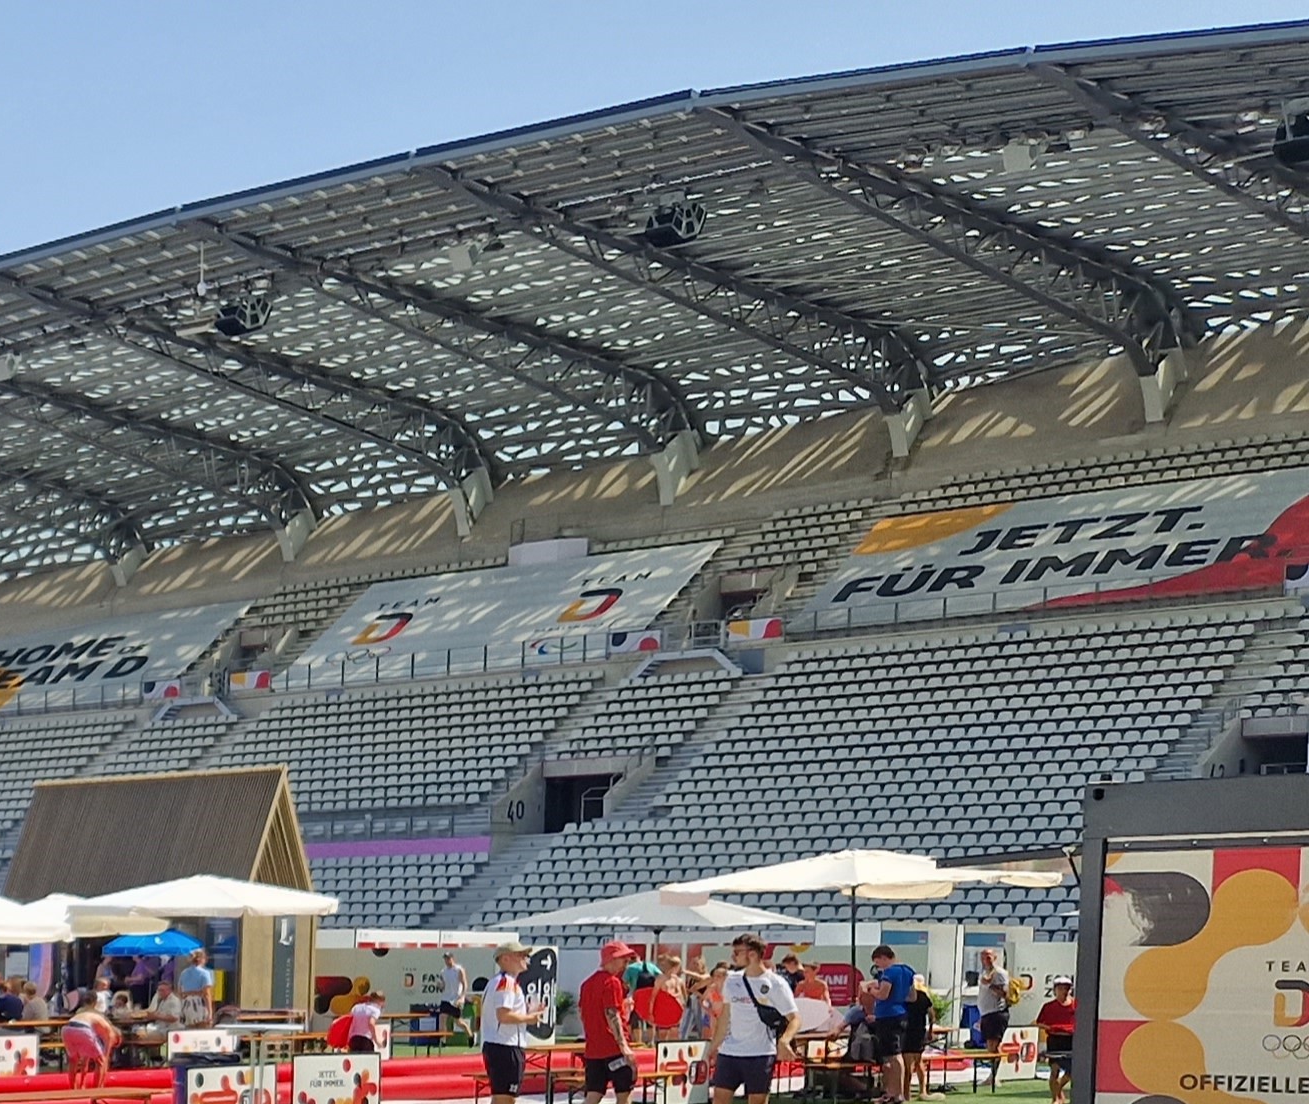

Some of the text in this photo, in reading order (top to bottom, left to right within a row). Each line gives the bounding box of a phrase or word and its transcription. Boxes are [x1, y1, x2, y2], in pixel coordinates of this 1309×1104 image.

[957, 505, 1205, 557] JETZT.
[581, 571, 652, 586] TEAM
[830, 563, 986, 603] FÜR
[378, 596, 441, 610] TEAM
[102, 656, 148, 679] D
[507, 800, 525, 825] 40
